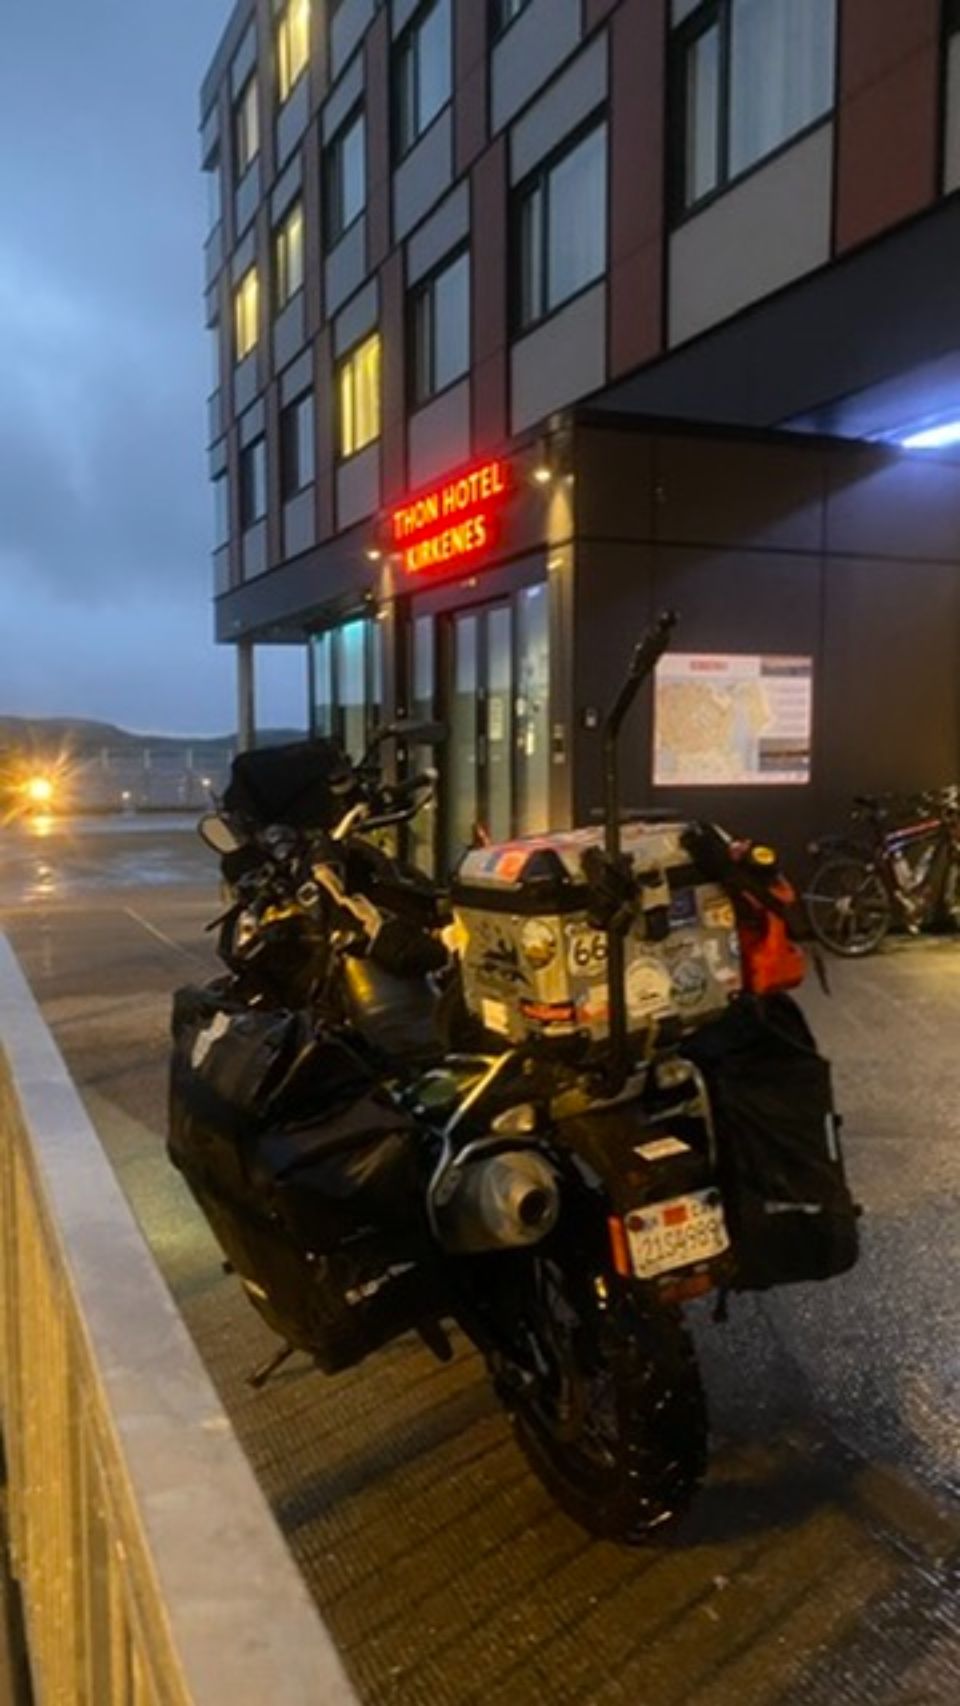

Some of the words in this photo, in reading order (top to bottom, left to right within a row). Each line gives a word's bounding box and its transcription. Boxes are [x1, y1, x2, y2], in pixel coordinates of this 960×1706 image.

[393, 494, 439, 539] THON
[442, 462, 504, 516] HOTEL
[406, 514, 486, 573] KIRKENES
